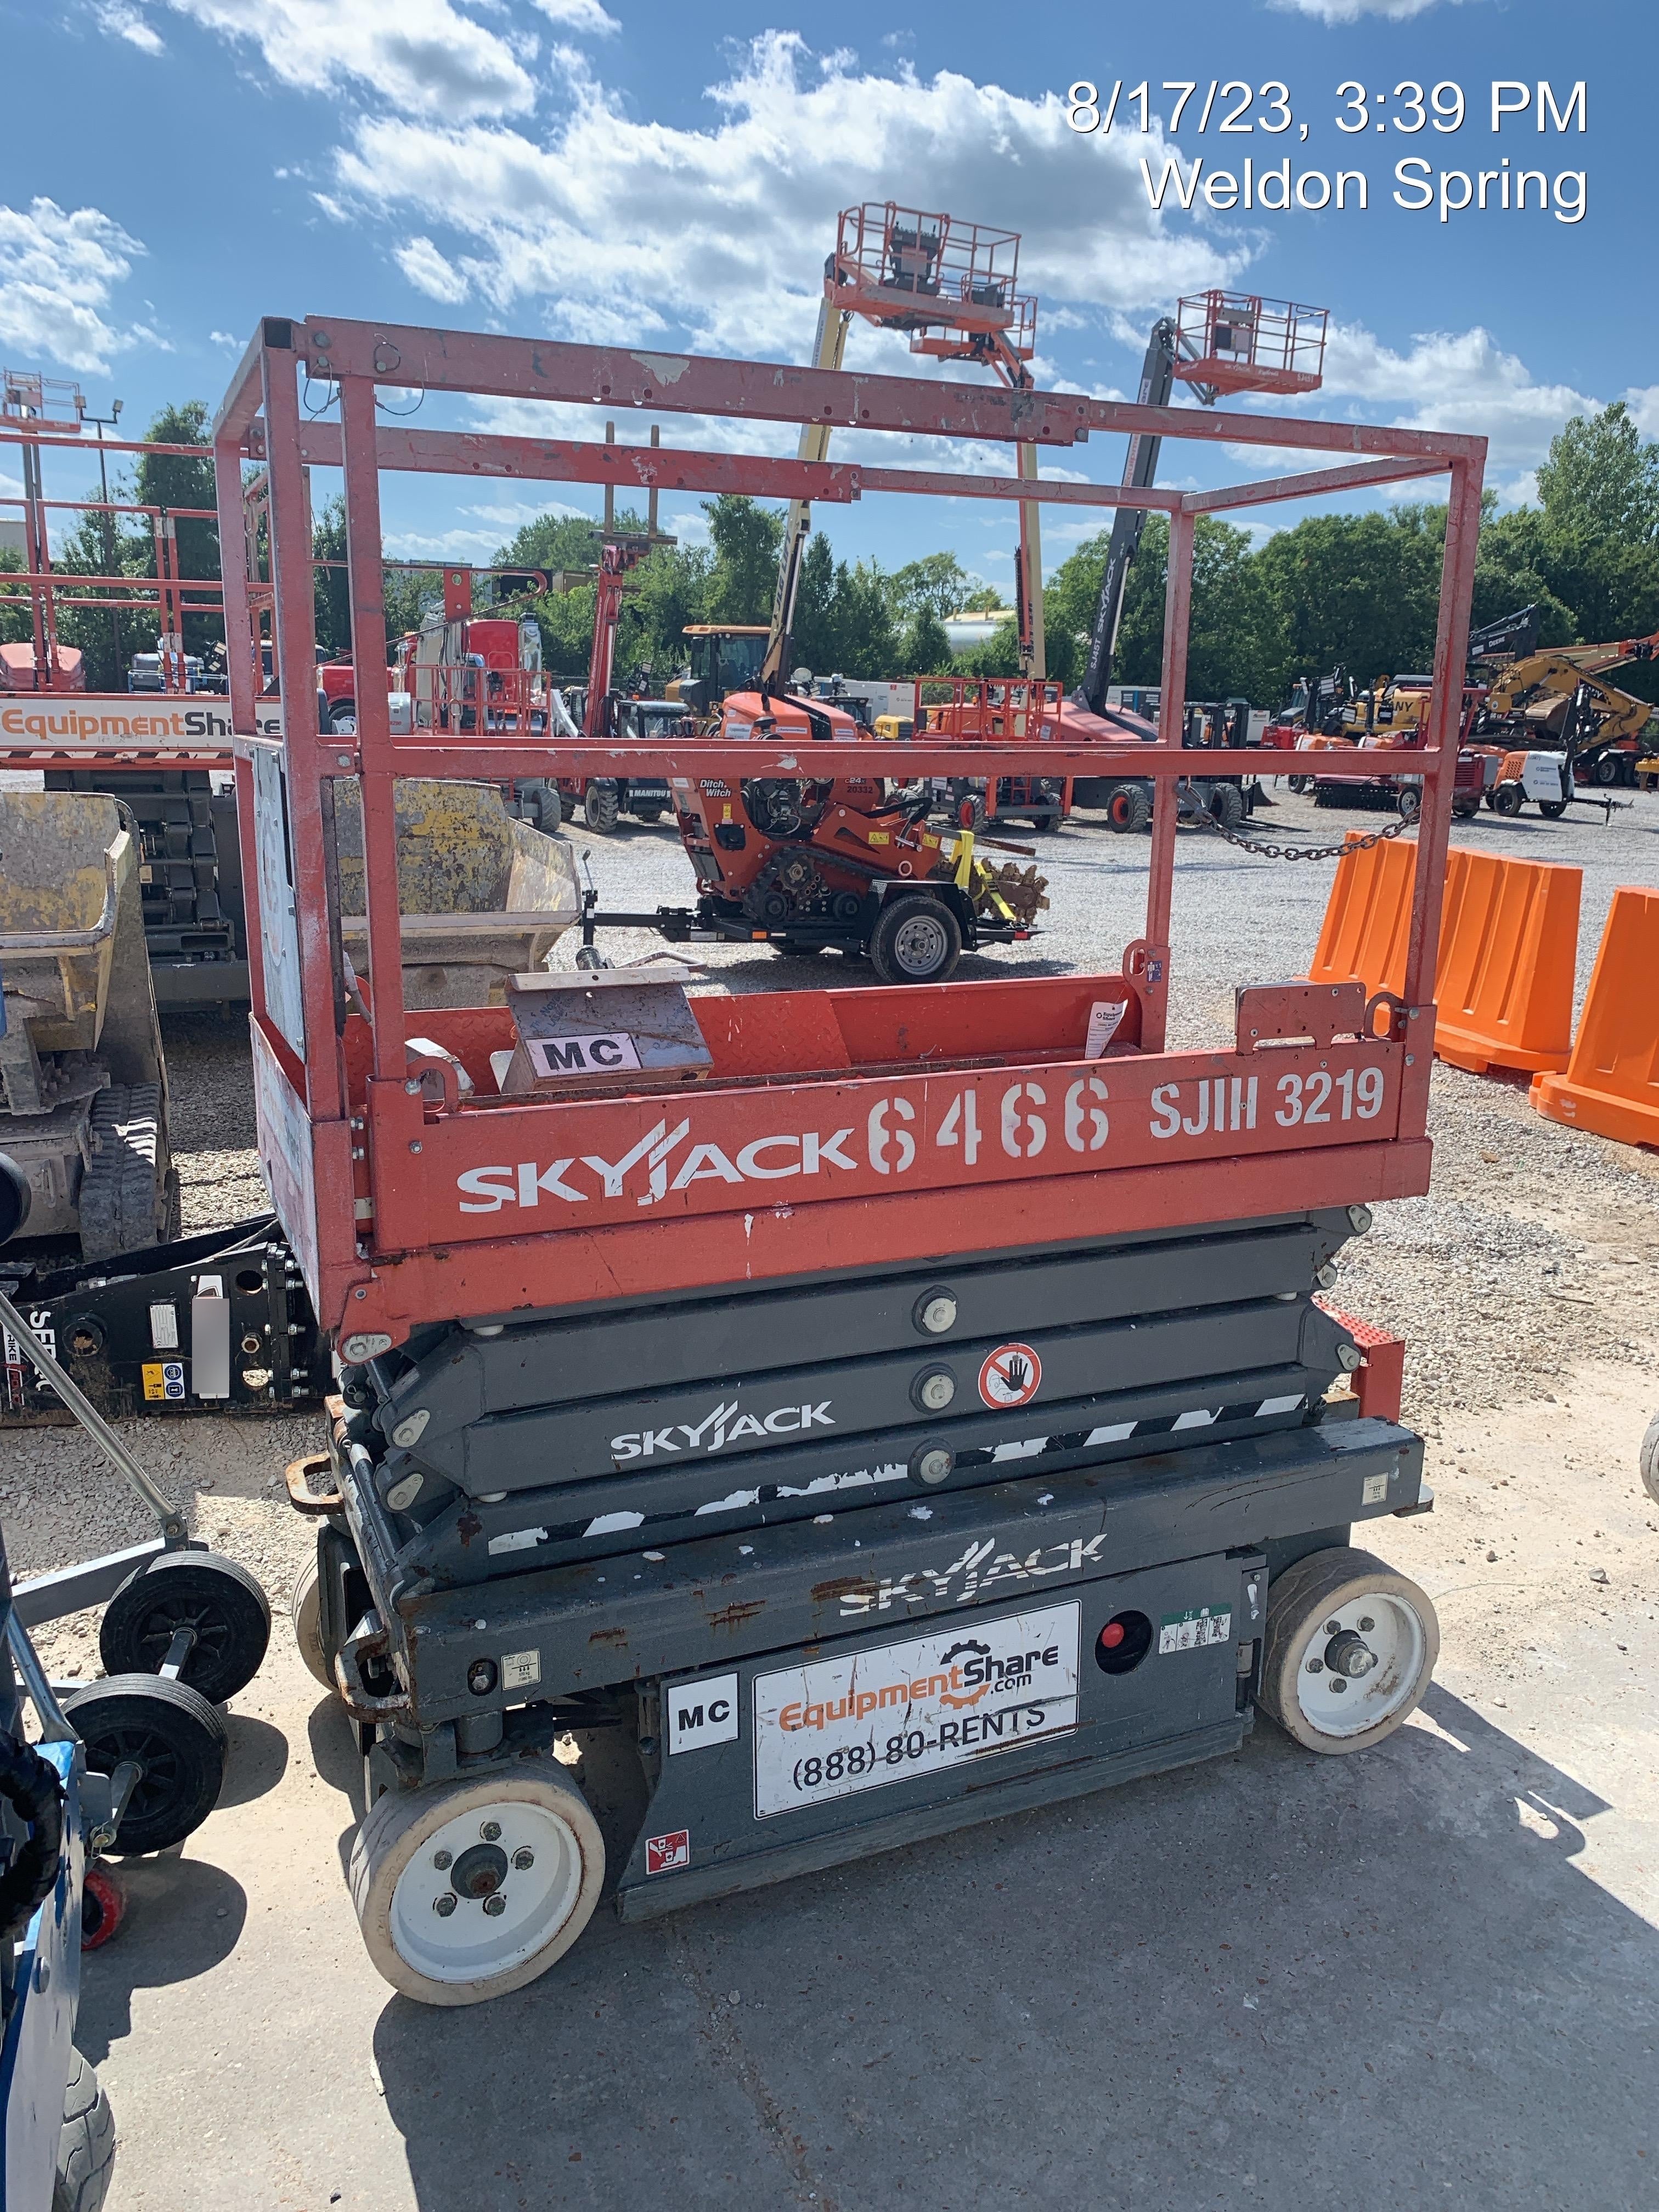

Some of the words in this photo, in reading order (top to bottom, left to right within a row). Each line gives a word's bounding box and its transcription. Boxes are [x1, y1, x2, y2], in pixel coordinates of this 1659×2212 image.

[1098, 557, 1116, 634] SKYJACK
[1091, 637, 1102, 669] SJ45T
[1488, 636, 1506, 647] DEERE
[1395, 701, 1414, 712] NY
[2, 708, 280, 740] EquipmentShe
[706, 788, 731, 797] Witch
[542, 1040, 623, 1071] MC
[1274, 1066, 1385, 1127] 3219
[867, 1077, 1109, 1175] 6466
[456, 1117, 859, 1213] SKYJACK
[7, 1334, 17, 1361] RIKE
[610, 1400, 836, 1460] SKYJACK
[839, 1533, 1108, 1616] SKYJACK
[779, 1644, 1059, 1731] EquipmentShare
[990, 1673, 1032, 1694] .com
[678, 1700, 731, 1731] MC
[792, 1741, 876, 1791] (888)
[885, 1706, 1046, 1765] 80-RENTS
